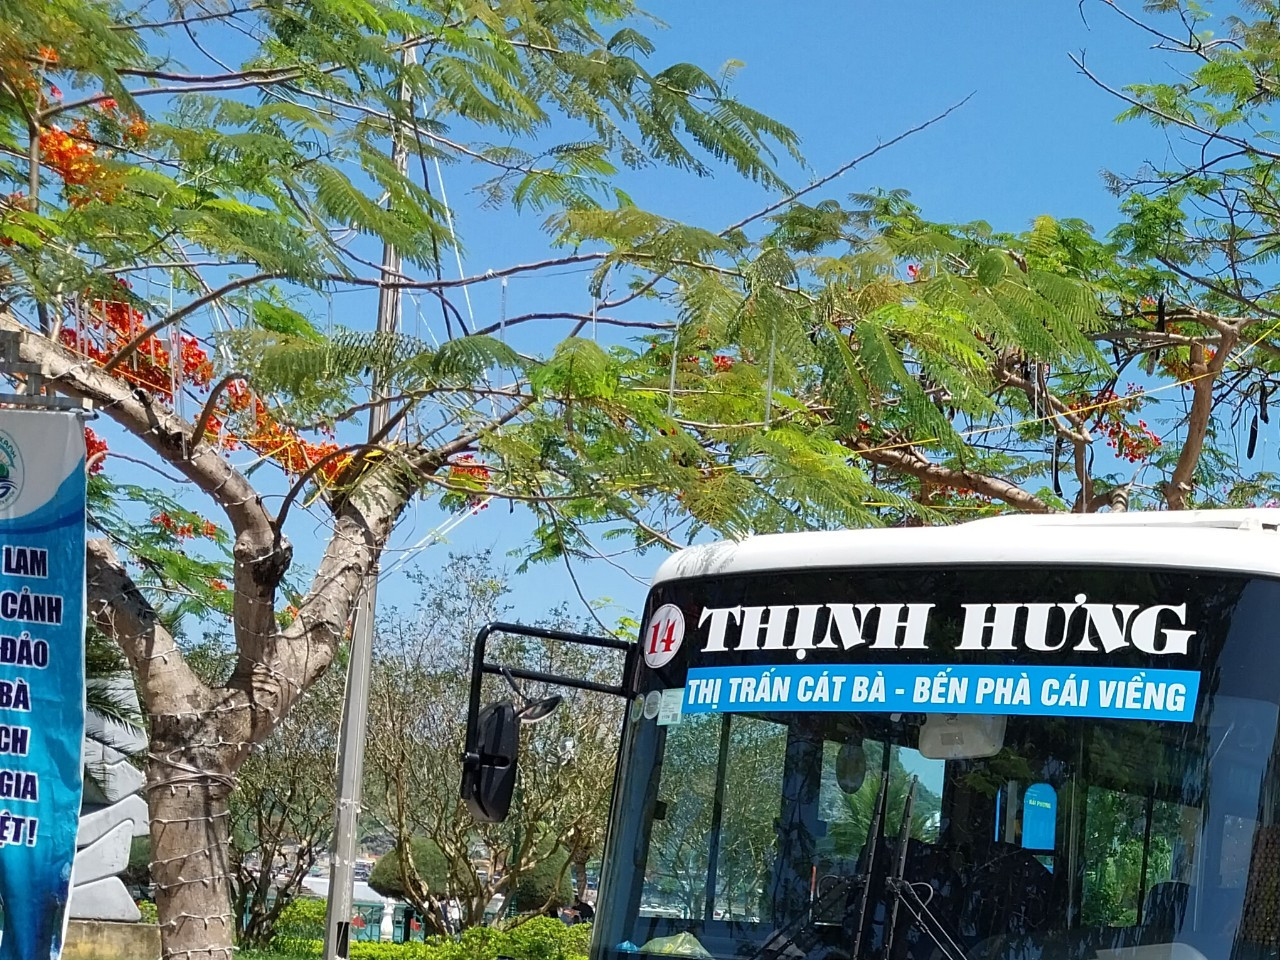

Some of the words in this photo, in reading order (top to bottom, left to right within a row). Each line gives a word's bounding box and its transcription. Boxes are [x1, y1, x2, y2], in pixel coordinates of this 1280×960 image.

[3, 545, 48, 578] LAM
[0, 586, 62, 625] CẢNH
[648, 618, 677, 654] 14
[698, 603, 935, 660] THỊNH
[955, 593, 1197, 655] HƯNG
[0, 677, 31, 712] BÀ
[688, 678, 722, 710] THỊ
[729, 667, 791, 704] TRẤN
[797, 670, 847, 703] CÁT
[851, 670, 886, 703] BÀ
[912, 667, 969, 704] BẾN
[975, 672, 1031, 706] PHÀ
[1041, 673, 1090, 707] CÁI
[1099, 672, 1187, 712] VIỀNG
[0, 770, 38, 802] GIA
